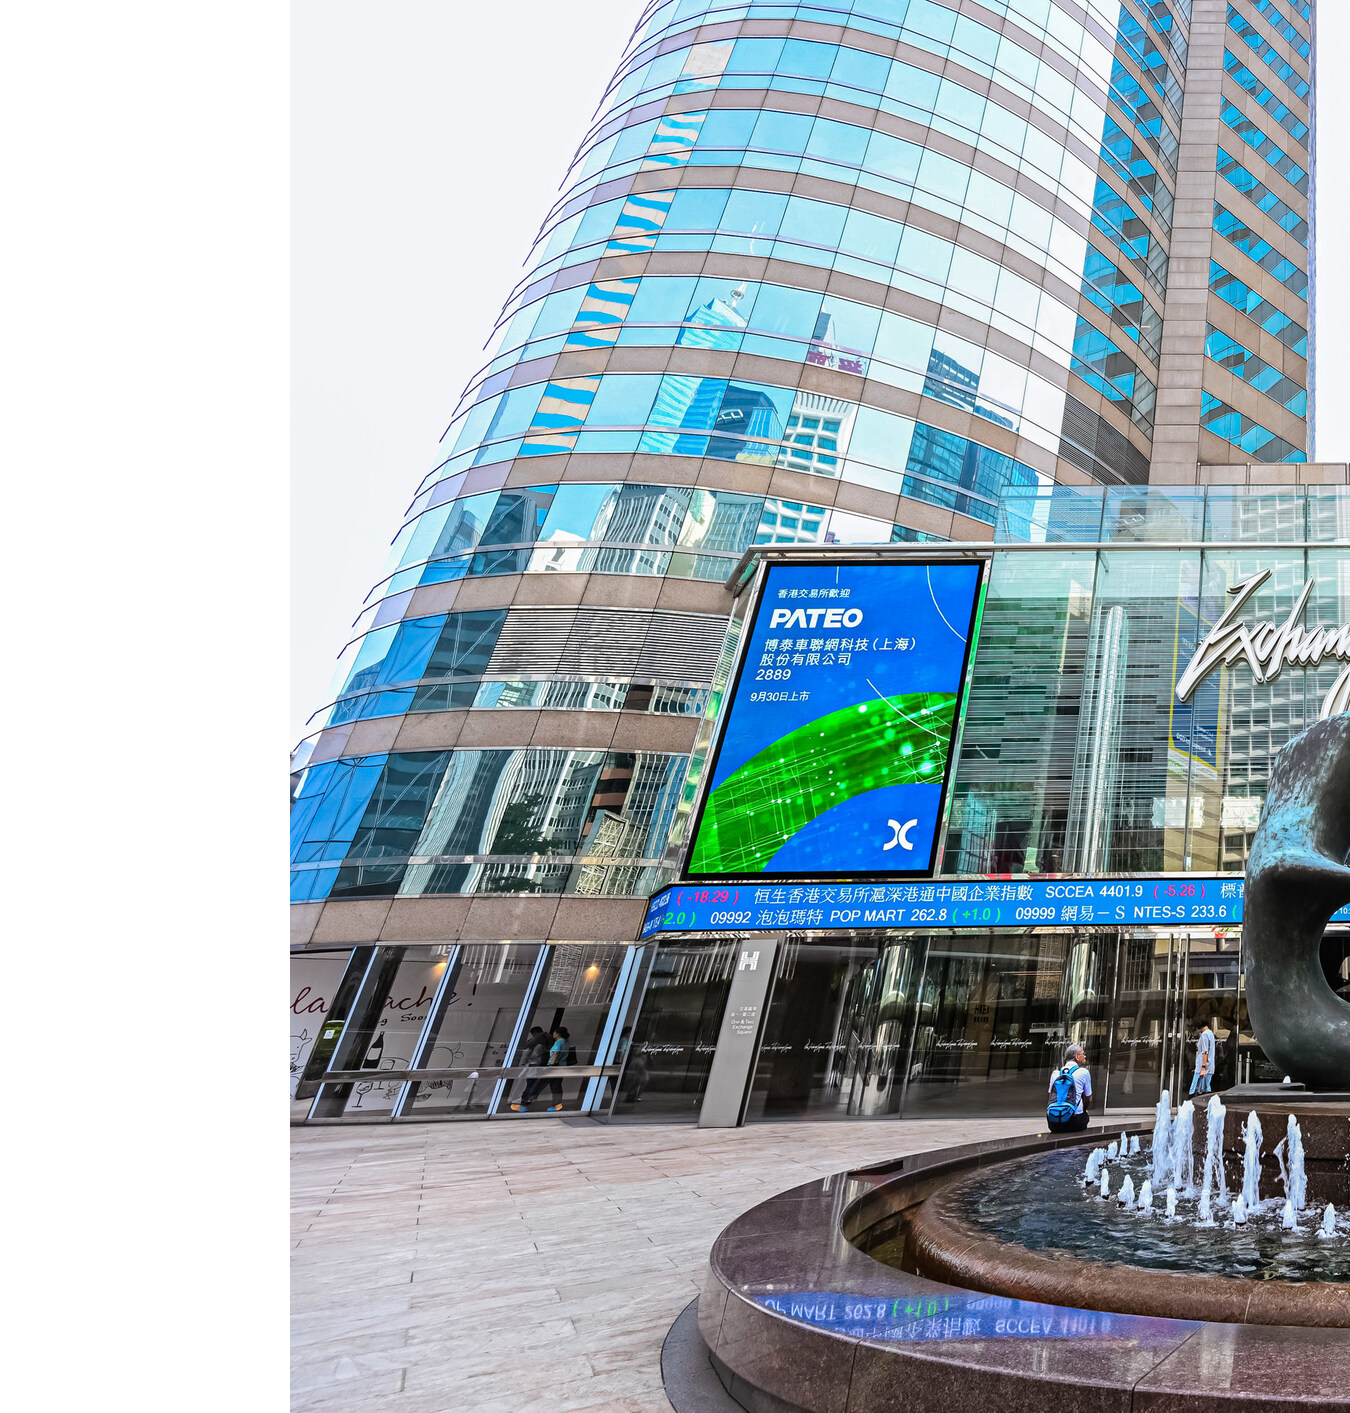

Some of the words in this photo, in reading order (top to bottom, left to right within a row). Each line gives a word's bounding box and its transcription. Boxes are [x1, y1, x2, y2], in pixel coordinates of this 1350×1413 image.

[777, 588, 851, 599] 香港交易所歡迎
[769, 608, 863, 629] PATEO
[759, 652, 851, 666] 股份有限公司
[755, 668, 792, 681] 2889
[750, 690, 811, 702] 9月30日上市
[1045, 885, 1094, 898] SCCEA
[1099, 885, 1143, 897] 4401.9
[710, 911, 752, 924] 09992
[755, 908, 824, 926] 泡泡瑪特
[830, 910, 862, 923] POP
[864, 909, 906, 922] MART
[910, 908, 947, 921] 262.8
[1015, 906, 1056, 920] 09999
[1134, 905, 1186, 918] NTES-S
[1191, 905, 1227, 918] 233.6
